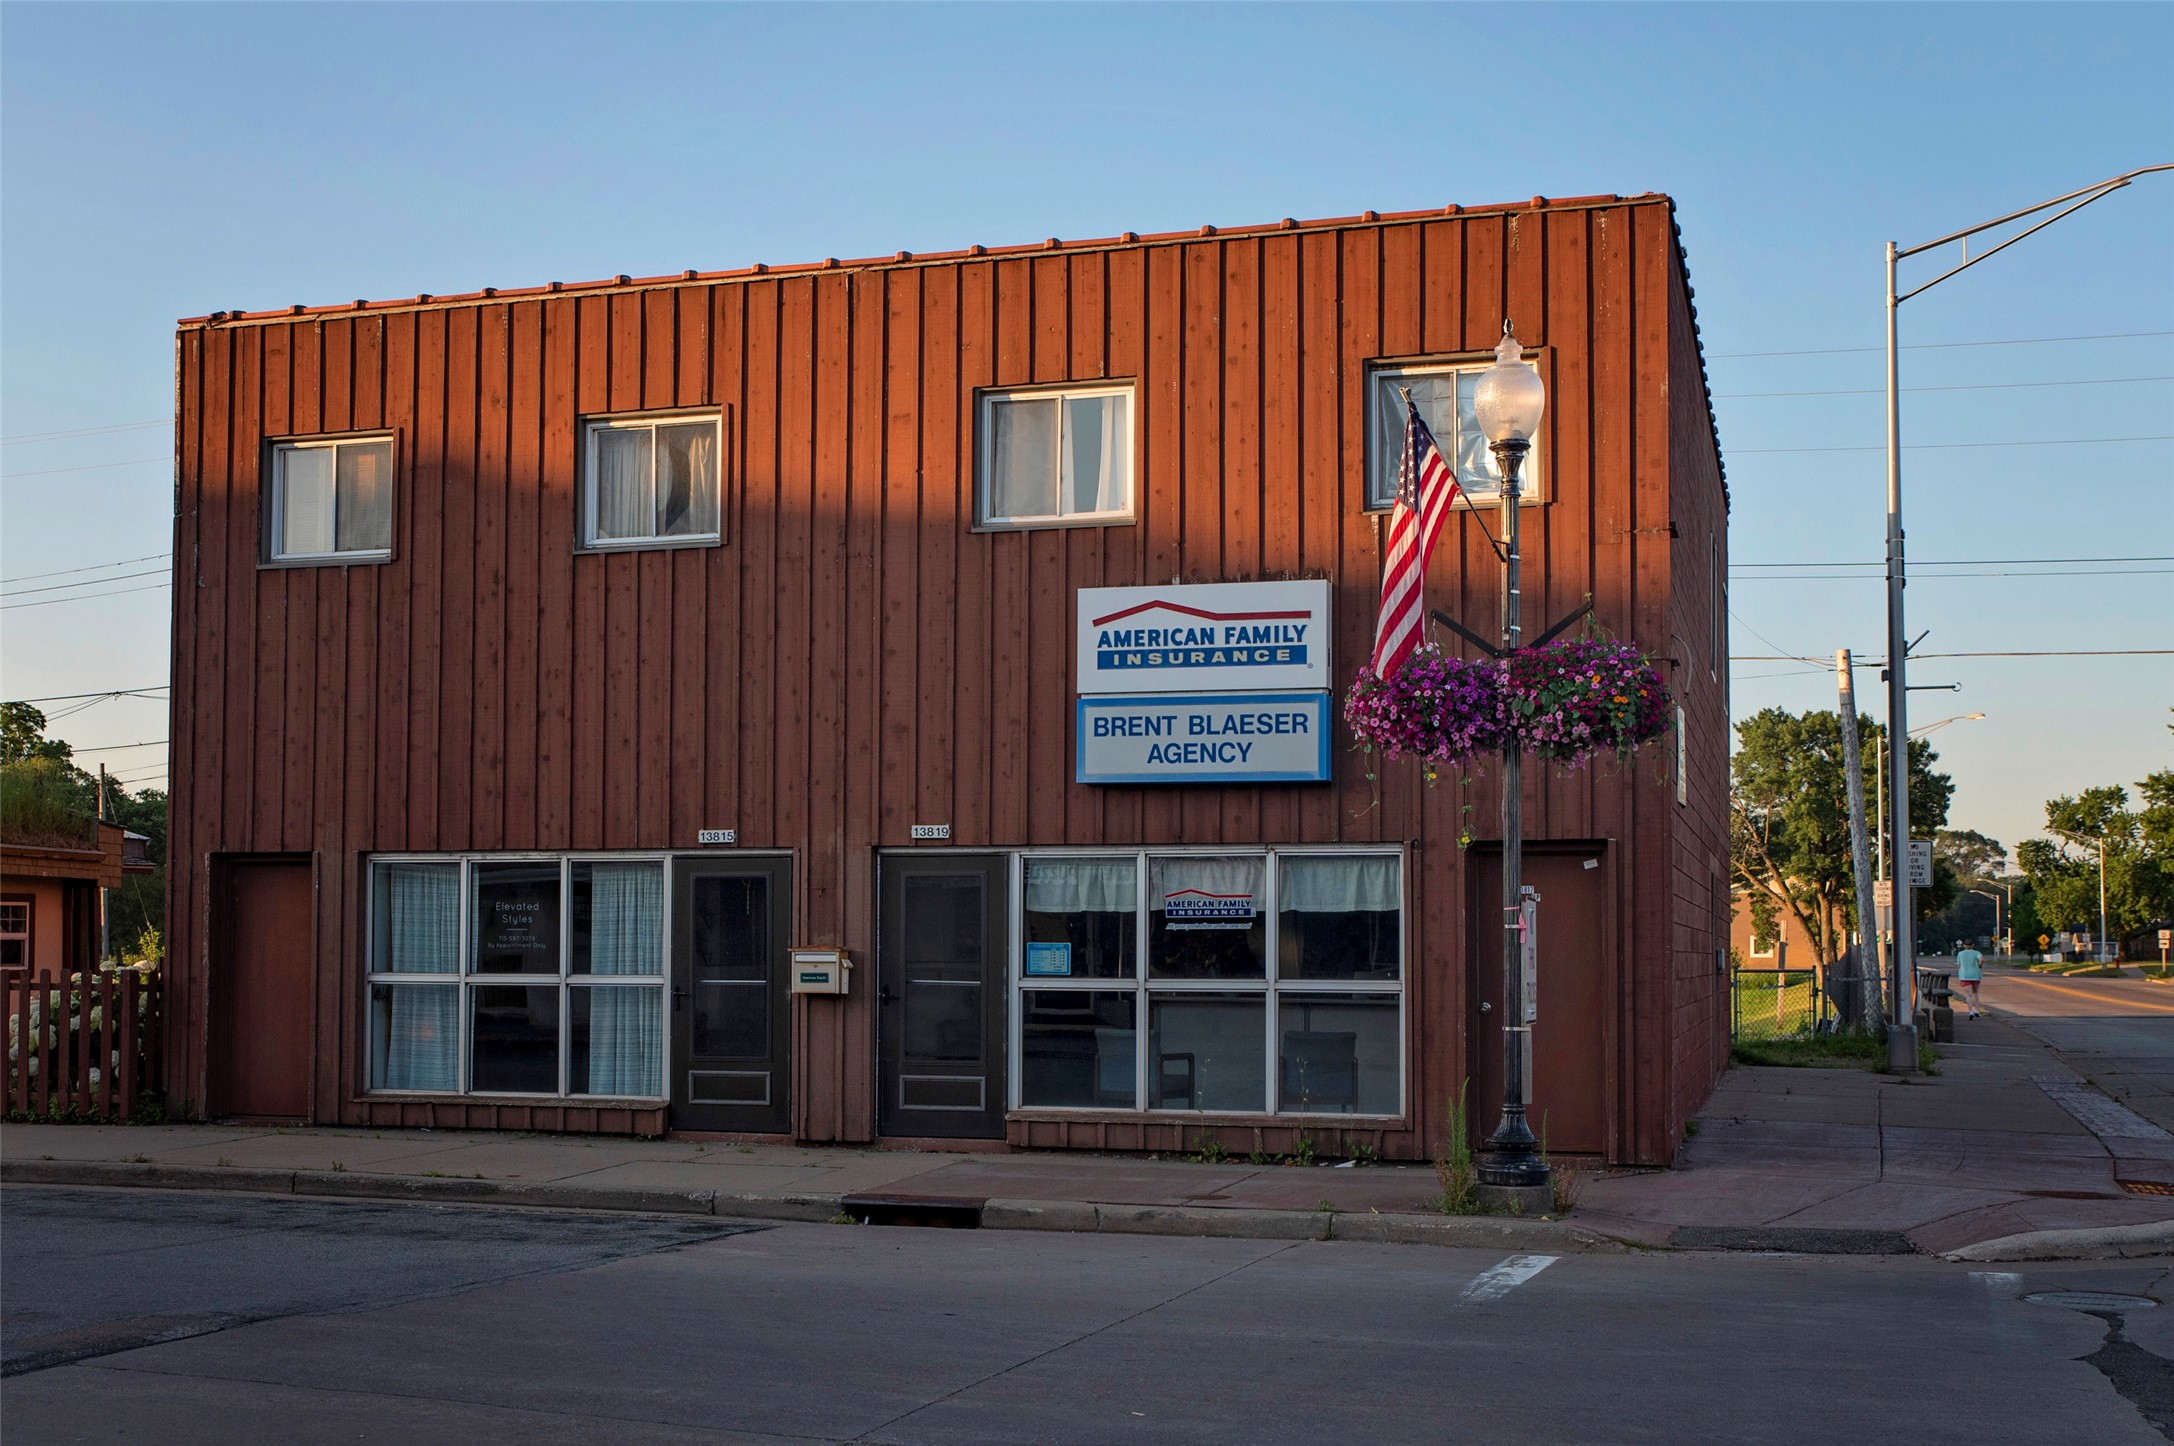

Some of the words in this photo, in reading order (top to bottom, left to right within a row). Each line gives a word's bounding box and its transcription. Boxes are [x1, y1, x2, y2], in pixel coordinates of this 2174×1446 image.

[1097, 627, 1215, 648] AMERICAN
[1224, 624, 1308, 645] FAMILY
[1113, 649, 1291, 666] INSURANCE
[1093, 715, 1178, 737] BRENT
[1189, 713, 1309, 735] BLAESER
[1147, 742, 1253, 764] AGENCY
[700, 831, 734, 842] 13815
[914, 827, 949, 837] 13819
[495, 901, 540, 911] Elevated
[1167, 900, 1215, 908] AMERICAN
[1218, 900, 1251, 908] FAMILY
[502, 914, 533, 925] Styles
